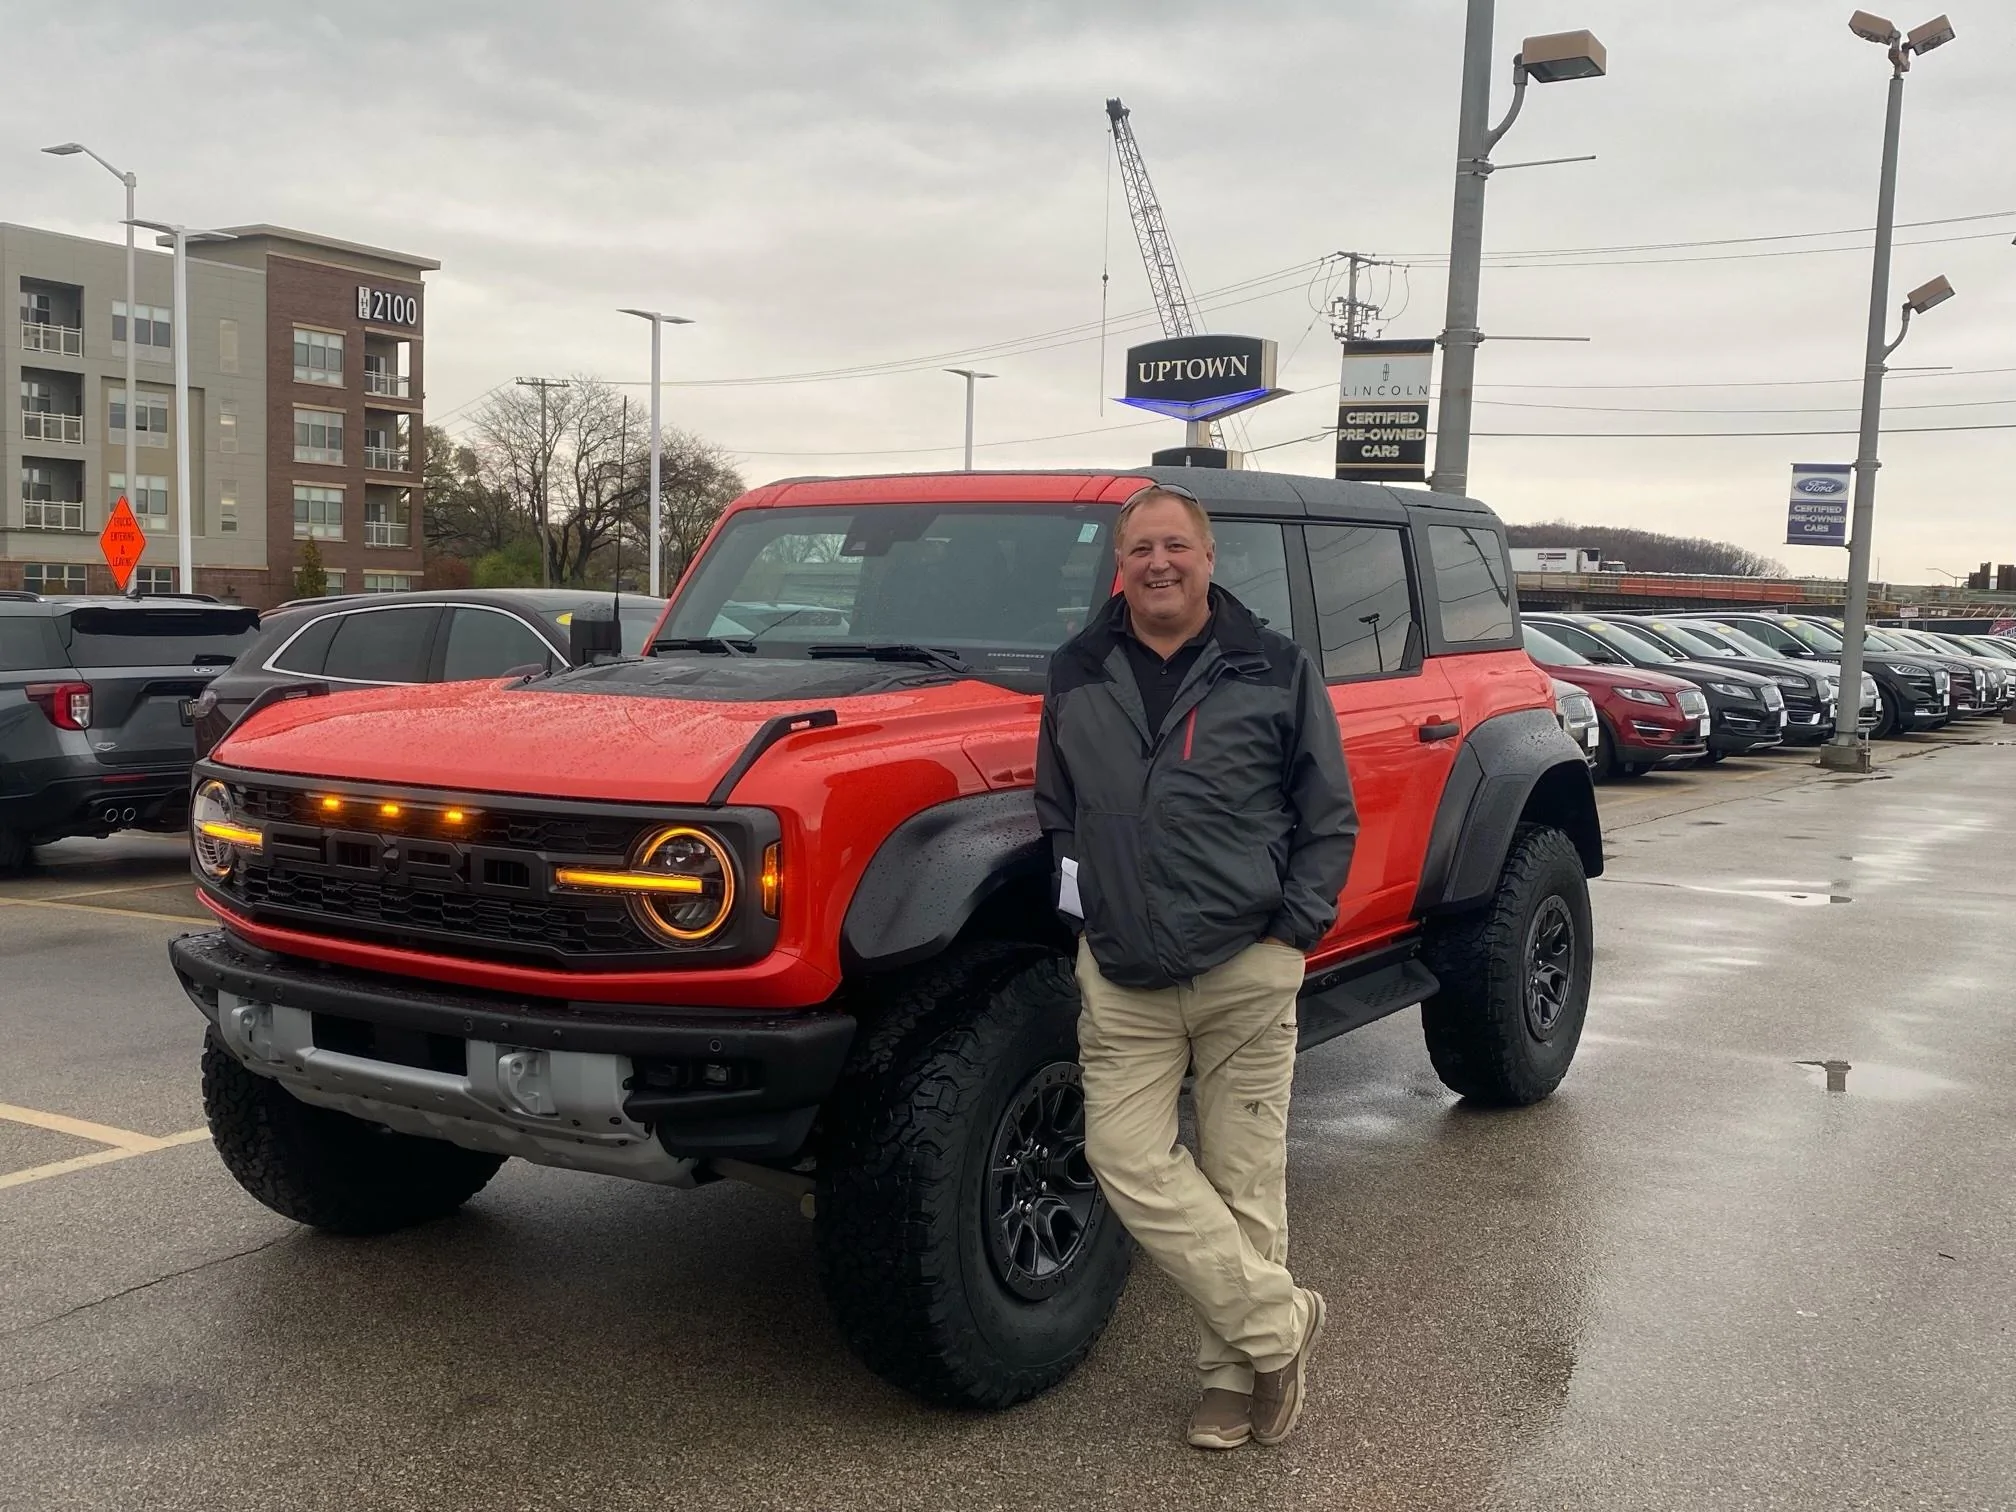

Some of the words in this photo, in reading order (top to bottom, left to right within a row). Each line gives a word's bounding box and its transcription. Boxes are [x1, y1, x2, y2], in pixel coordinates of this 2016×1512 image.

[373, 291, 417, 325] 2100
[1138, 354, 1250, 383] UPTOWN
[1343, 385, 1428, 397] LINCOLN
[1346, 412, 1420, 425] CERTIFIED
[1338, 428, 1427, 441] PRE-OWNED
[1361, 445, 1400, 458] CARS
[1805, 480, 1835, 493] Ford
[1794, 504, 1842, 514] CERTIFIED
[1789, 514, 1846, 524] PRE-OWNED
[1803, 523, 1829, 533] CARS
[110, 531, 135, 542] ENTERING
[266, 822, 547, 902] FORD
